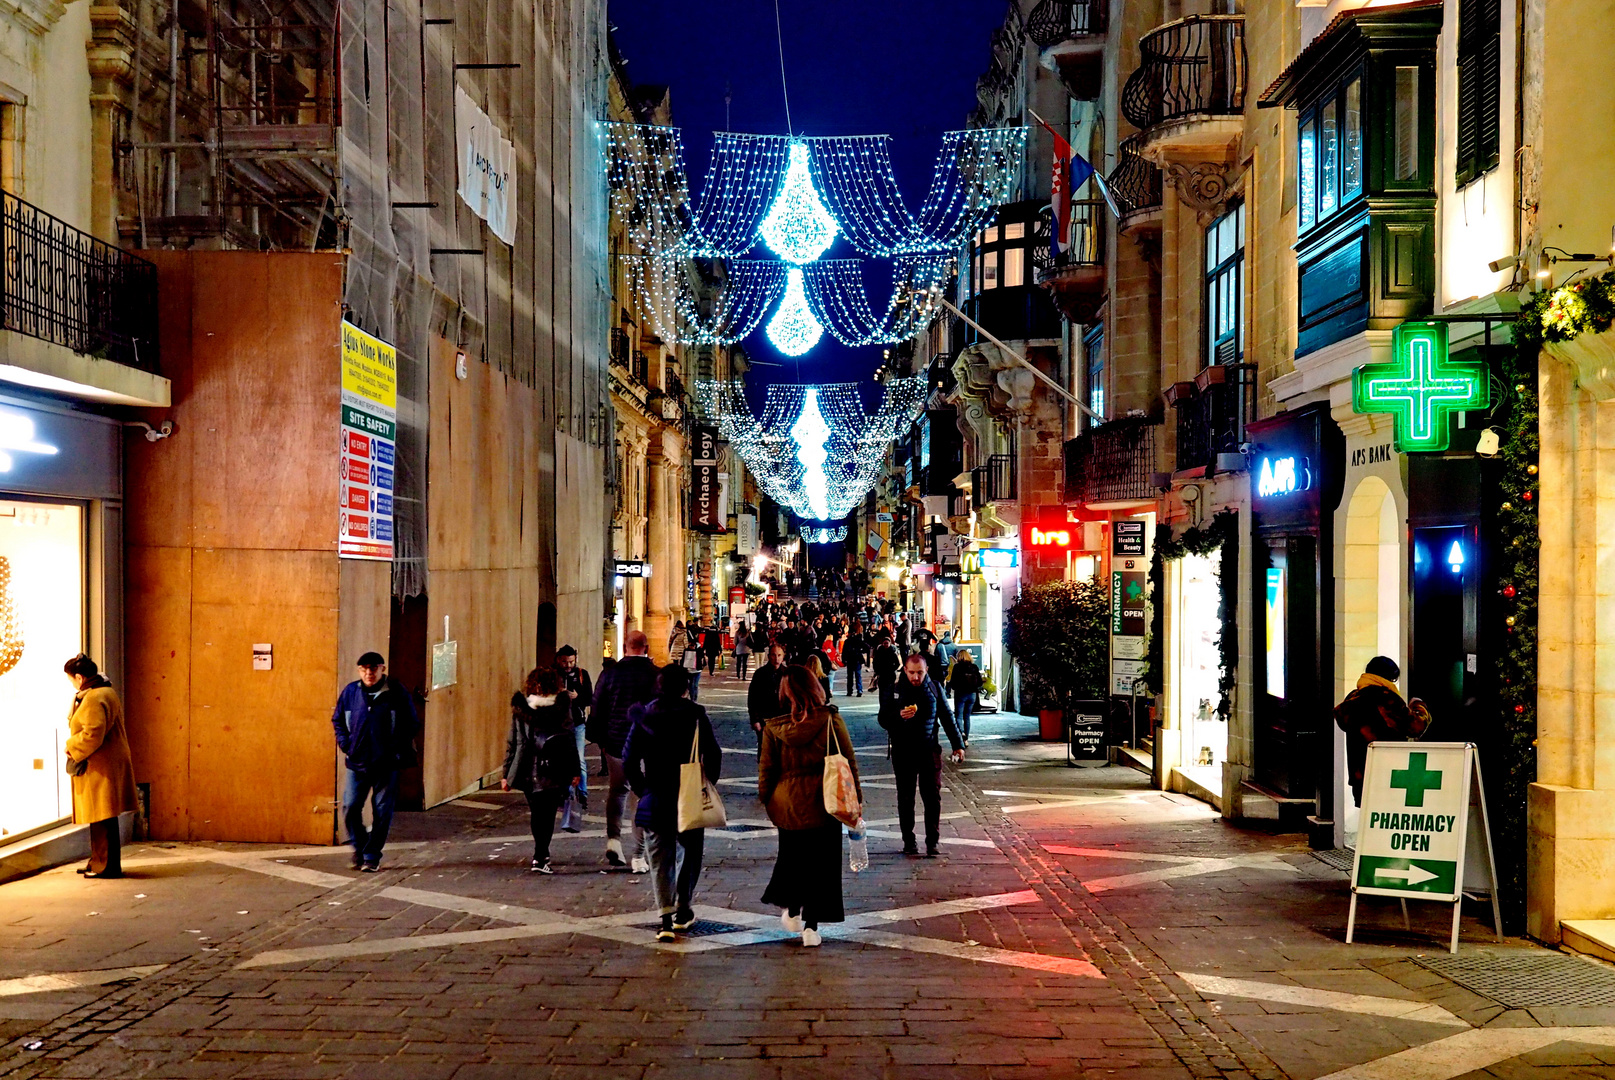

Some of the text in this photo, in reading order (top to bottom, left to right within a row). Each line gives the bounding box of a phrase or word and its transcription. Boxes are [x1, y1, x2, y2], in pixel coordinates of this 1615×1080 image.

[360, 337, 376, 362] Stone
[377, 345, 395, 371] Works
[349, 411, 391, 436] SITE SAFETY
[1351, 443, 1392, 467] APS BANK
[1123, 544, 1142, 552] Beauty
[1113, 573, 1121, 632] PHARMACY
[1369, 811, 1456, 833] PHARMACY
[1390, 833, 1431, 852] OPEN
